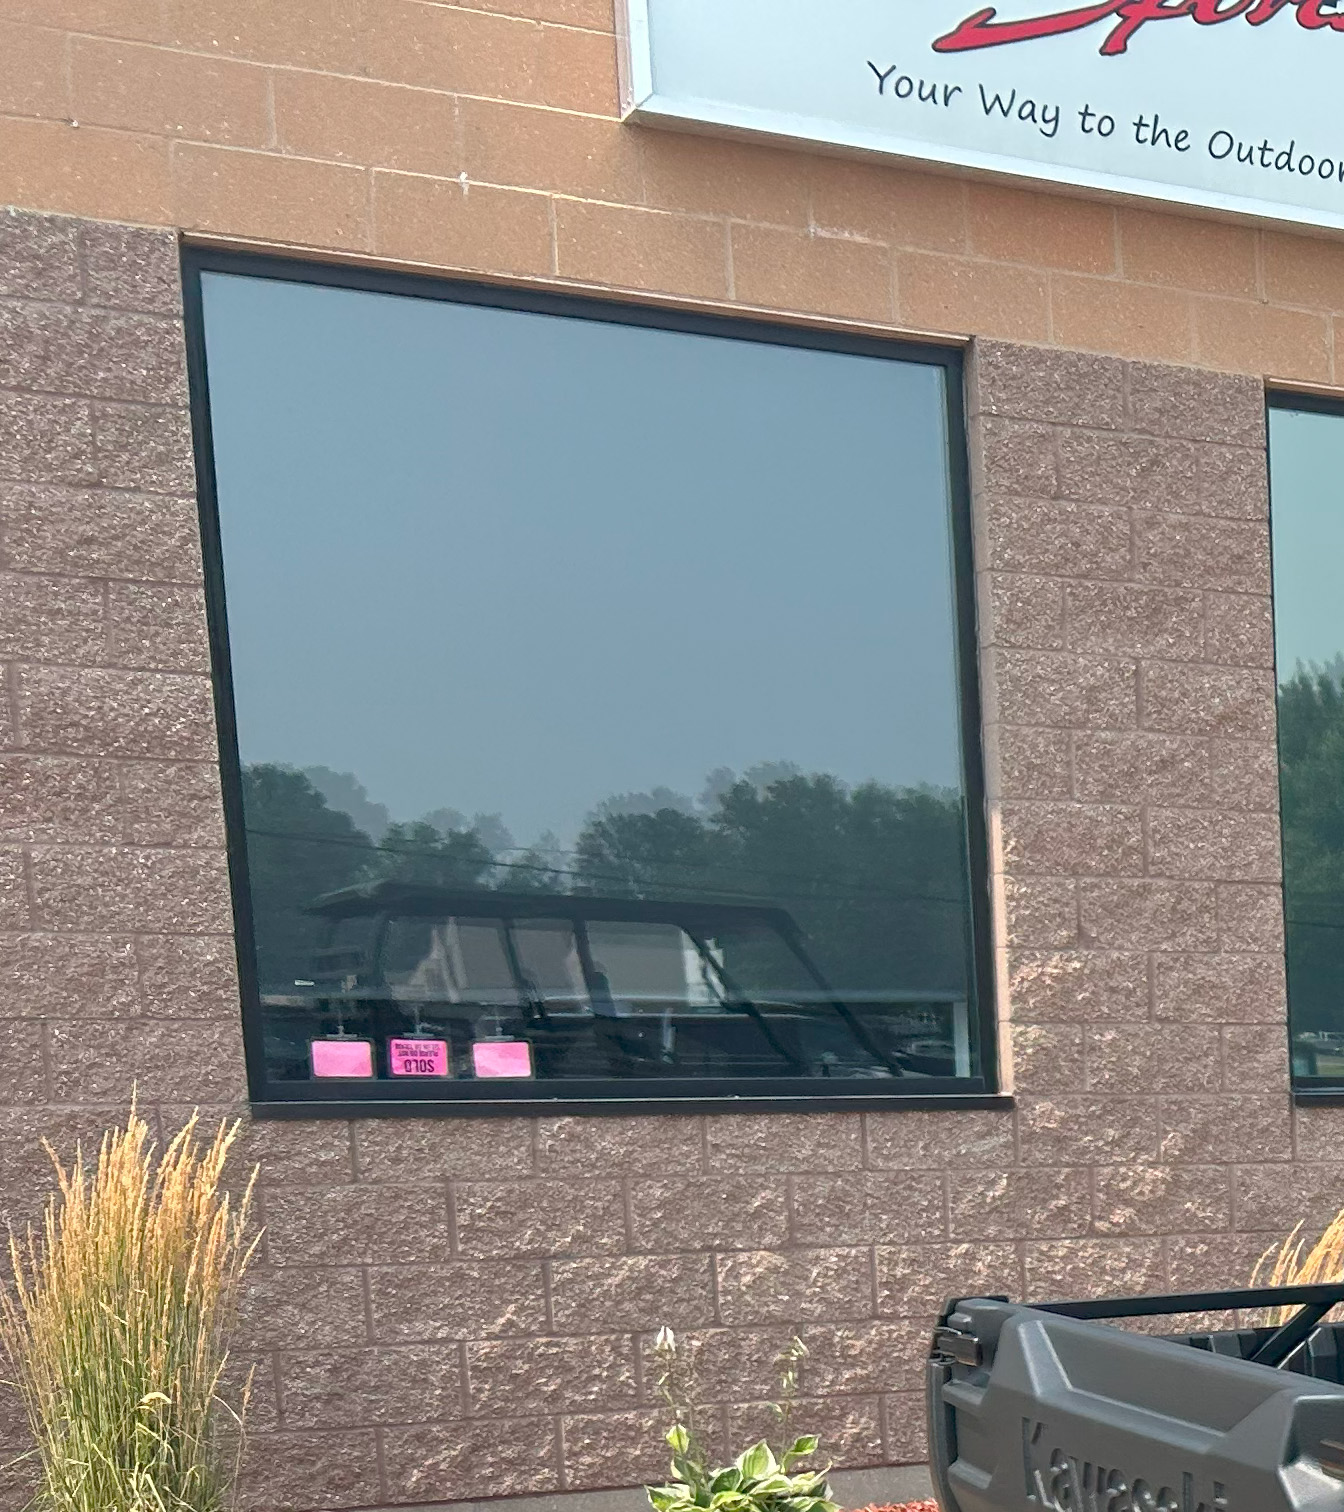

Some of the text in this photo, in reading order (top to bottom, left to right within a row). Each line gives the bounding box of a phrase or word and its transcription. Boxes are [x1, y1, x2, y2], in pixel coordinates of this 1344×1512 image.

[867, 60, 963, 107] Your
[978, 83, 1060, 138] Way
[1078, 104, 1115, 137] to
[1132, 114, 1191, 152] the
[404, 1059, 435, 1073] SOLD
